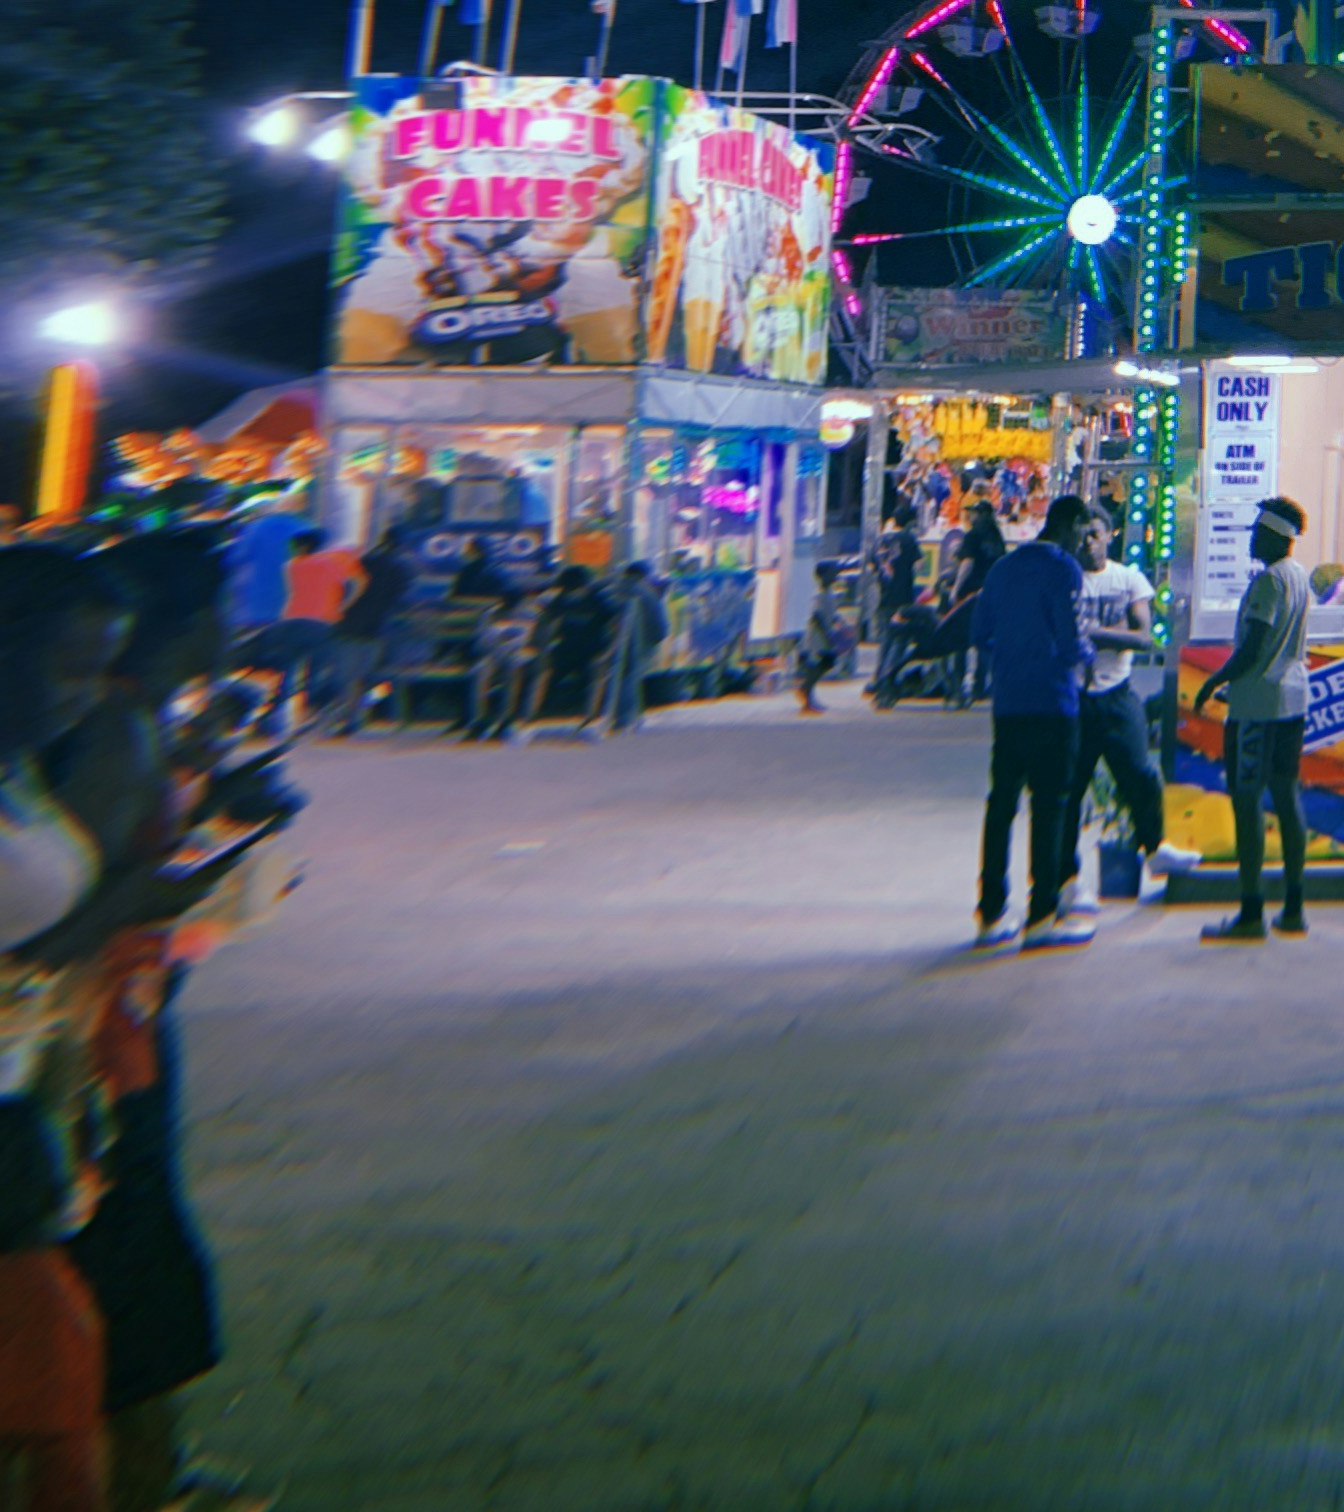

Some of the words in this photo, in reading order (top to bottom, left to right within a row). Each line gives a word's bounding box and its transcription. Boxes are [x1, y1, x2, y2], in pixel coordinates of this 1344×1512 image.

[406, 175, 601, 220] CAKES
[1217, 376, 1270, 397] CASH
[1217, 401, 1268, 422] ONLY
[1226, 444, 1255, 459] ATM
